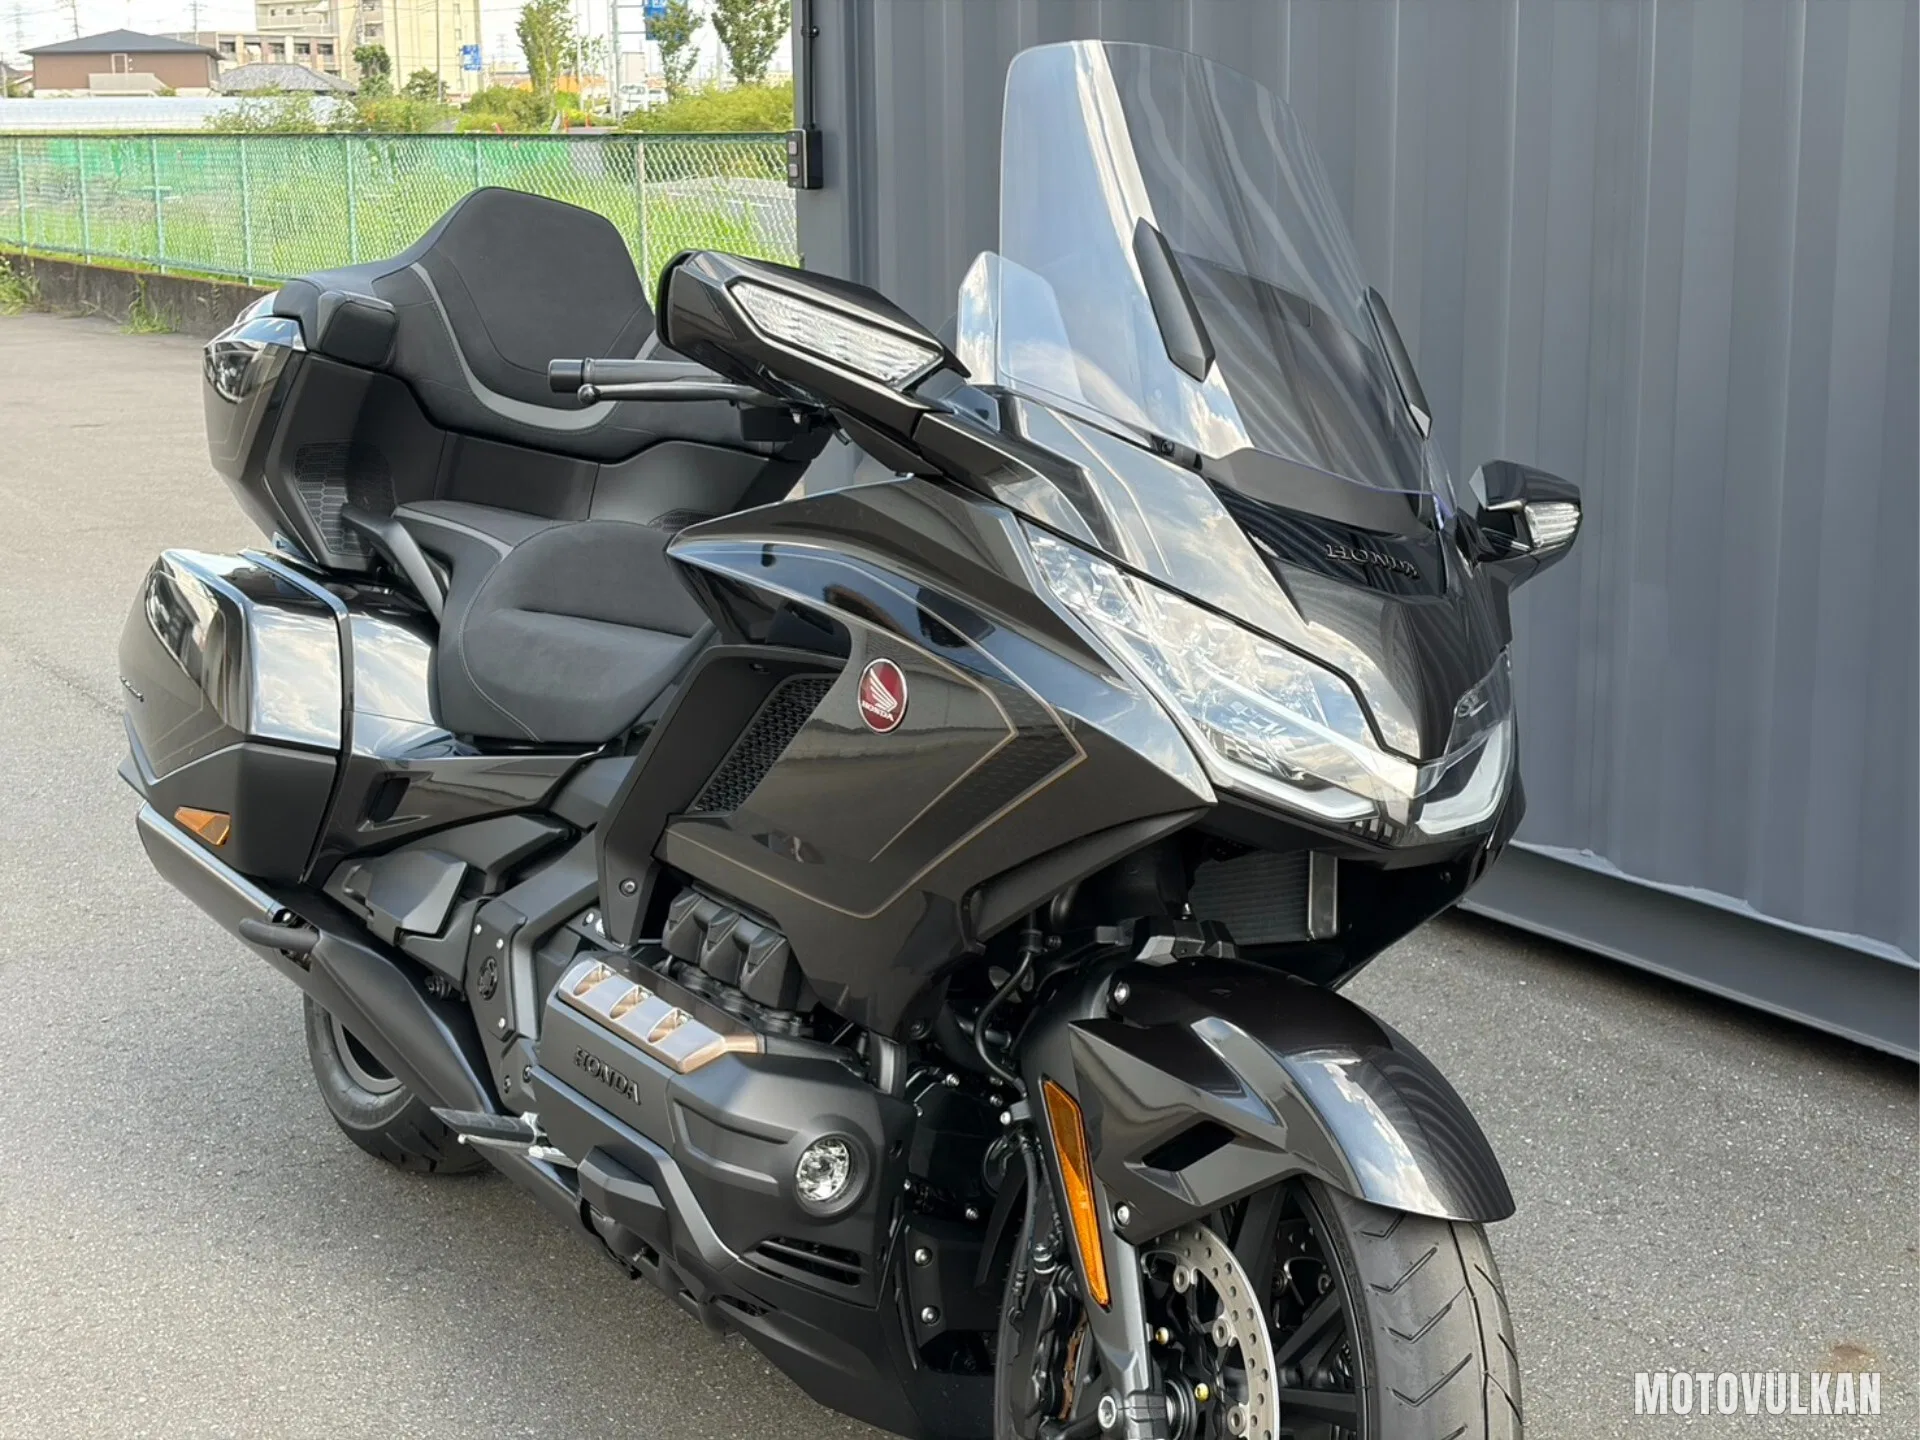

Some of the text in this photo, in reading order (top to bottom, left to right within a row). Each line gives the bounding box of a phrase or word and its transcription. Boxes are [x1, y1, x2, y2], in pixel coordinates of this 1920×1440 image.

[1325, 543, 1418, 576] HONDA
[862, 700, 895, 722] HONDA
[574, 1045, 641, 1106] HONDA
